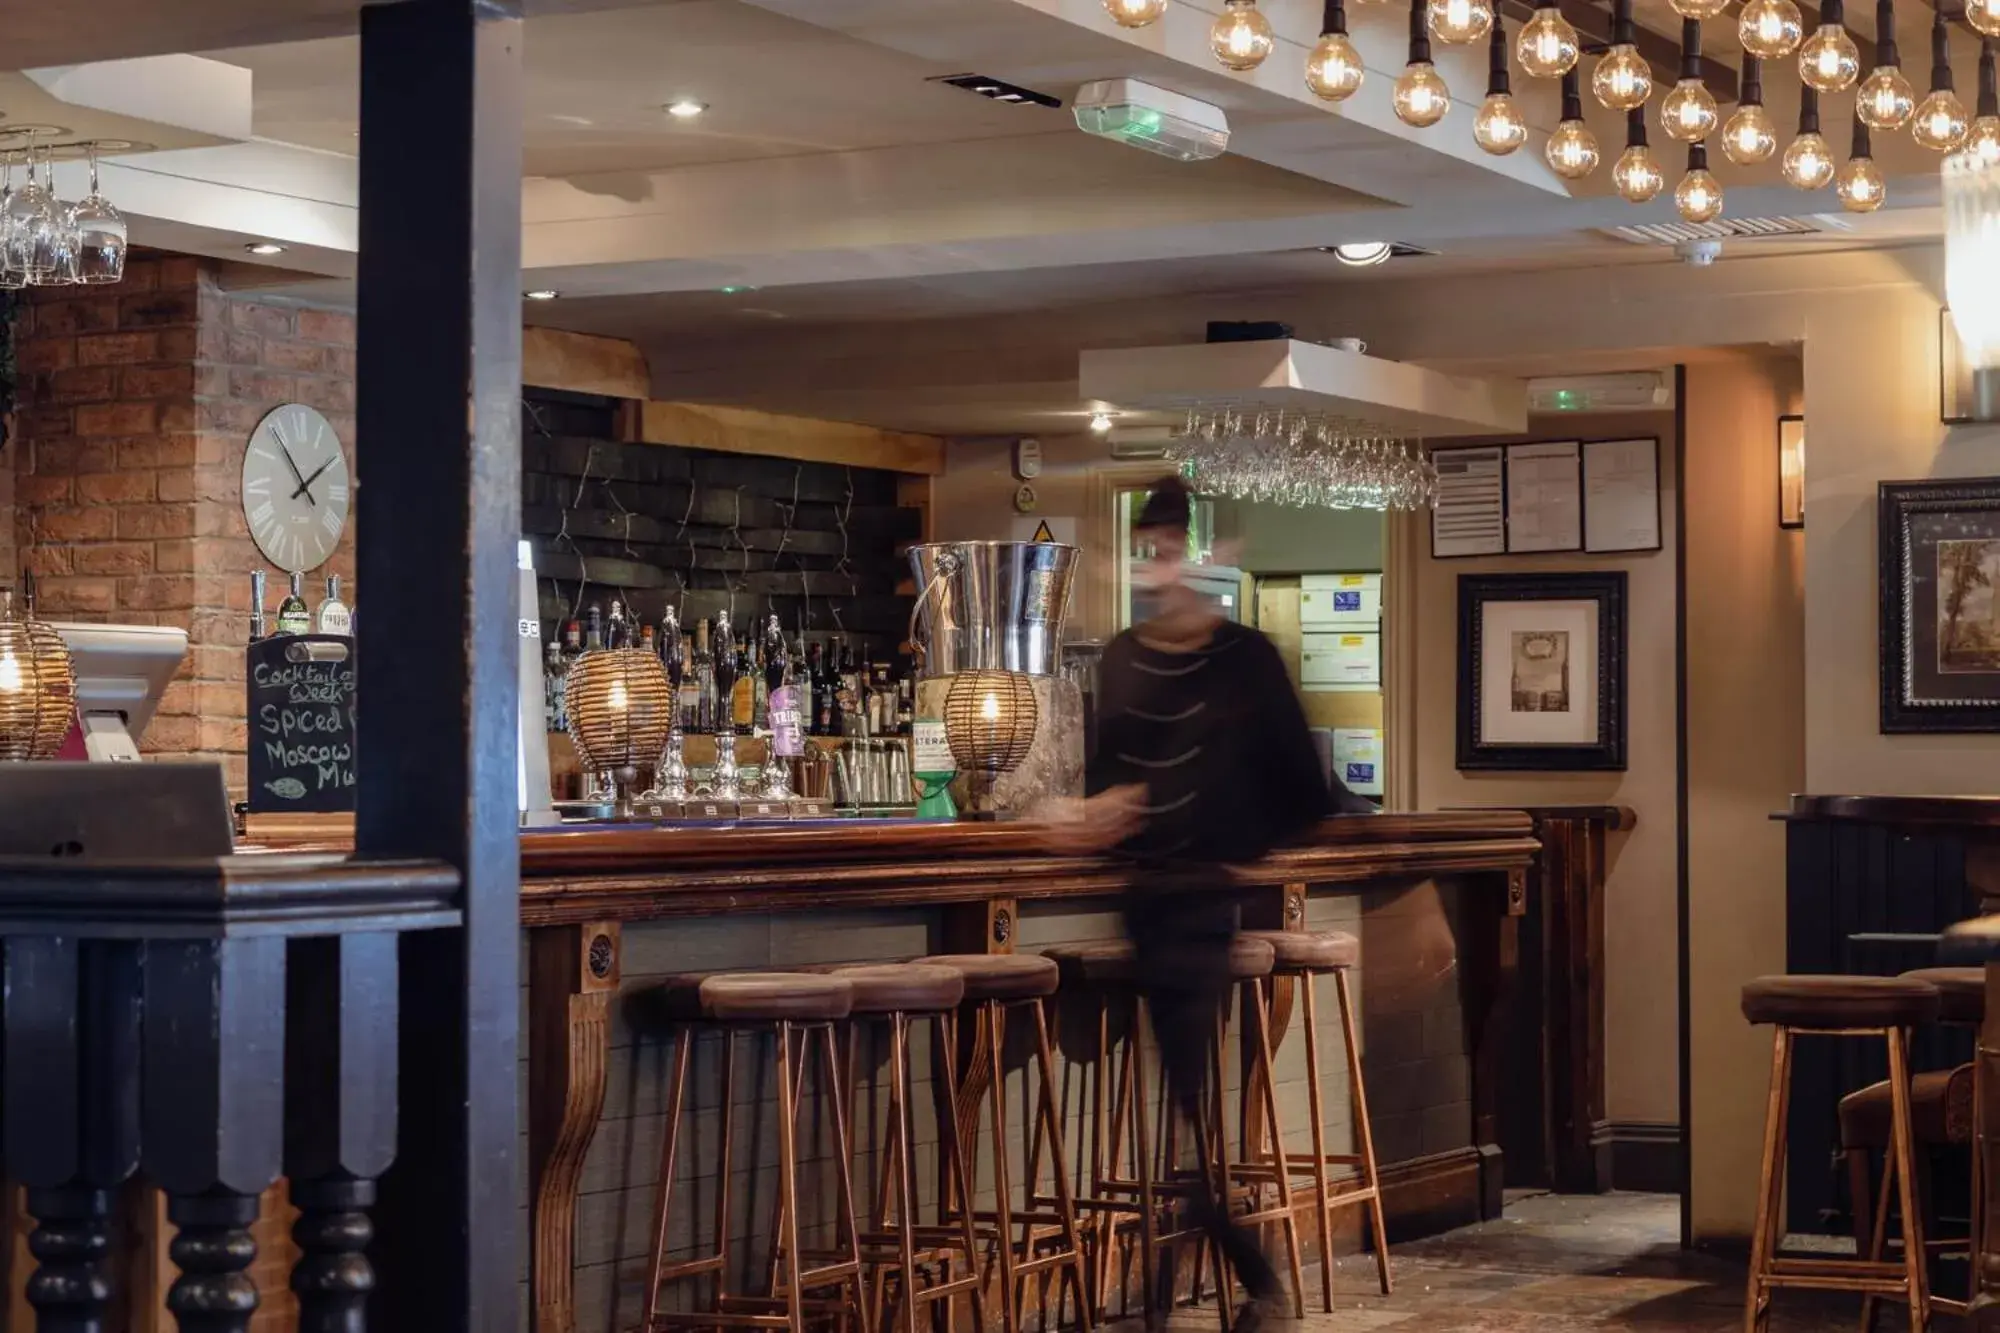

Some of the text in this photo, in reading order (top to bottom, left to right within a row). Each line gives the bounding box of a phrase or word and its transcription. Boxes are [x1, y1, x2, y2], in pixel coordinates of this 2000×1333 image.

[254, 662, 337, 685] Cocktail
[288, 683, 343, 703] Week
[260, 703, 344, 738] Spiced
[264, 740, 351, 769] Moscow
